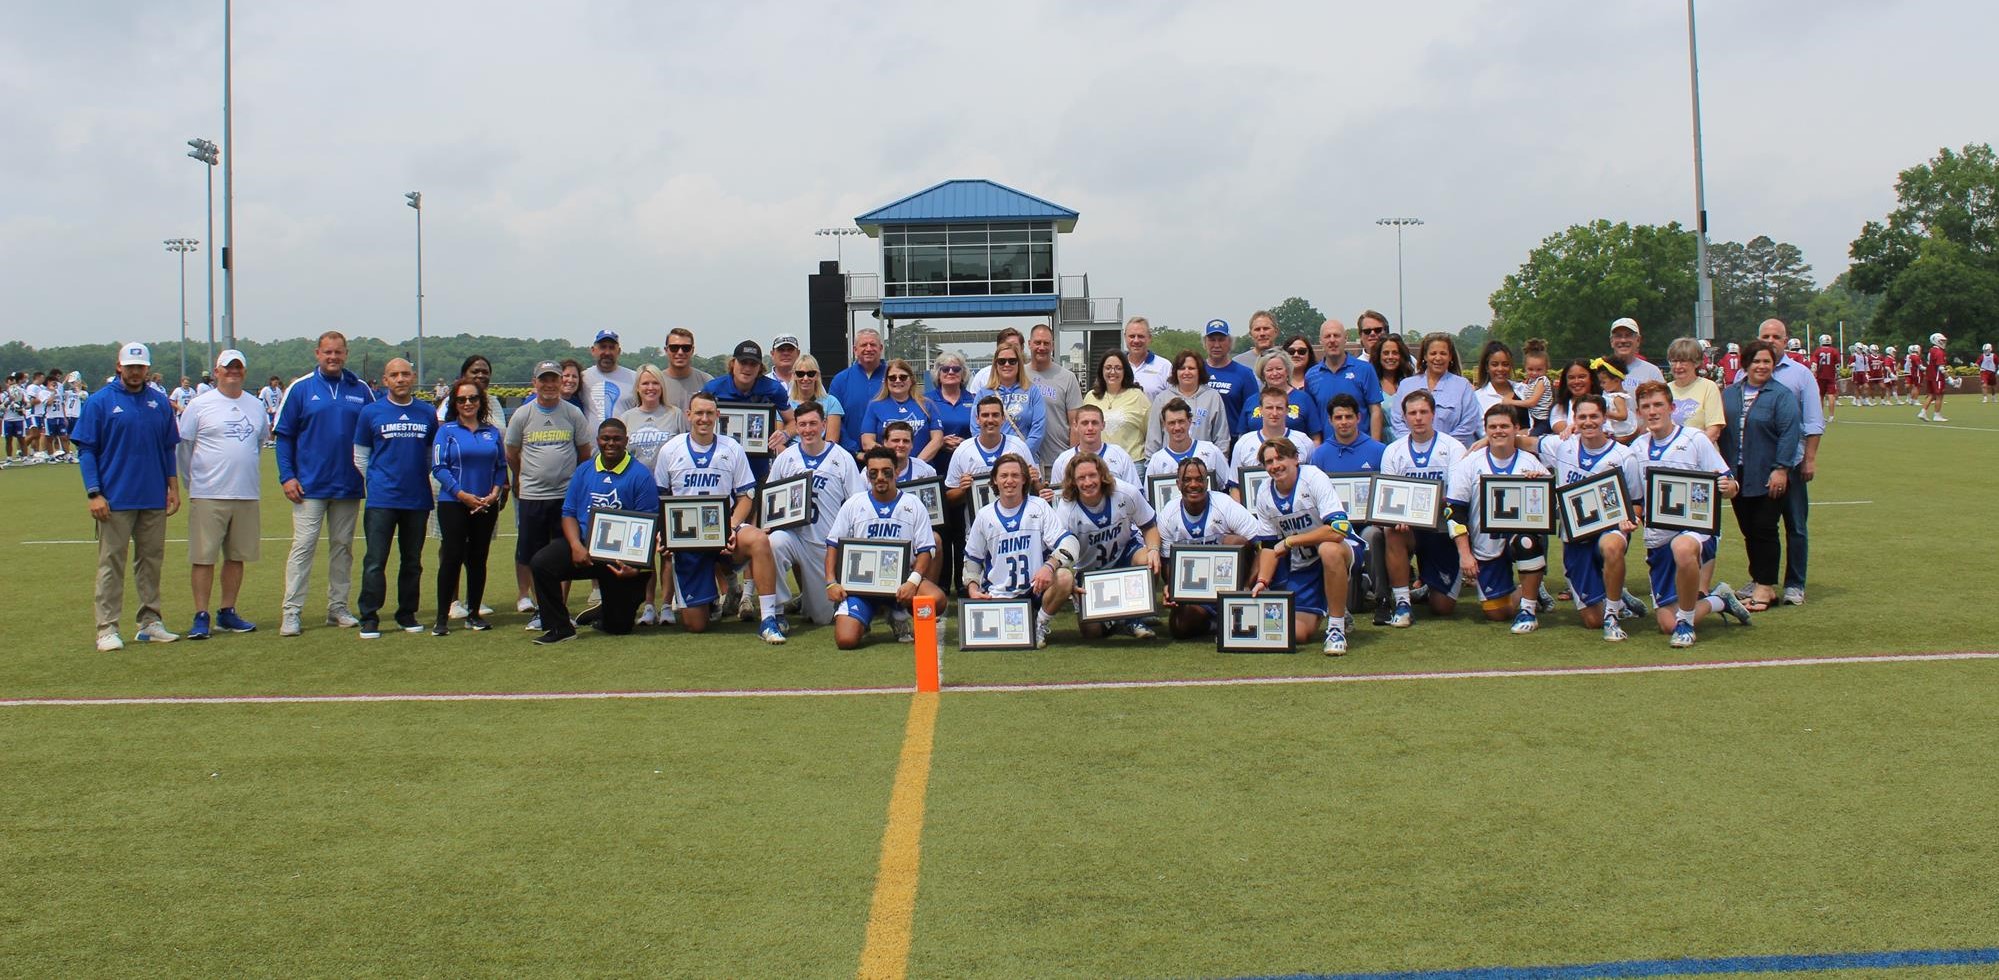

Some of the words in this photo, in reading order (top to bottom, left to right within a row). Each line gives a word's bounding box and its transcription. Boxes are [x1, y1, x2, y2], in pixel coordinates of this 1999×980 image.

[1729, 358, 1739, 370] 11
[1819, 352, 1831, 366] 21
[381, 423, 428, 434] LIMESTONE
[628, 431, 671, 445] SAINTS
[767, 492, 786, 522] L
[1380, 487, 1405, 515] L
[1494, 488, 1519, 519] L
[1571, 495, 1600, 527] L
[1660, 482, 1685, 516] L
[596, 521, 622, 552] L
[672, 509, 697, 538] L
[849, 552, 874, 583] L
[1006, 554, 1031, 592] 33
[1181, 559, 1208, 590] L
[1093, 581, 1120, 609] L
[972, 611, 999, 639] L
[1231, 606, 1258, 639] L
